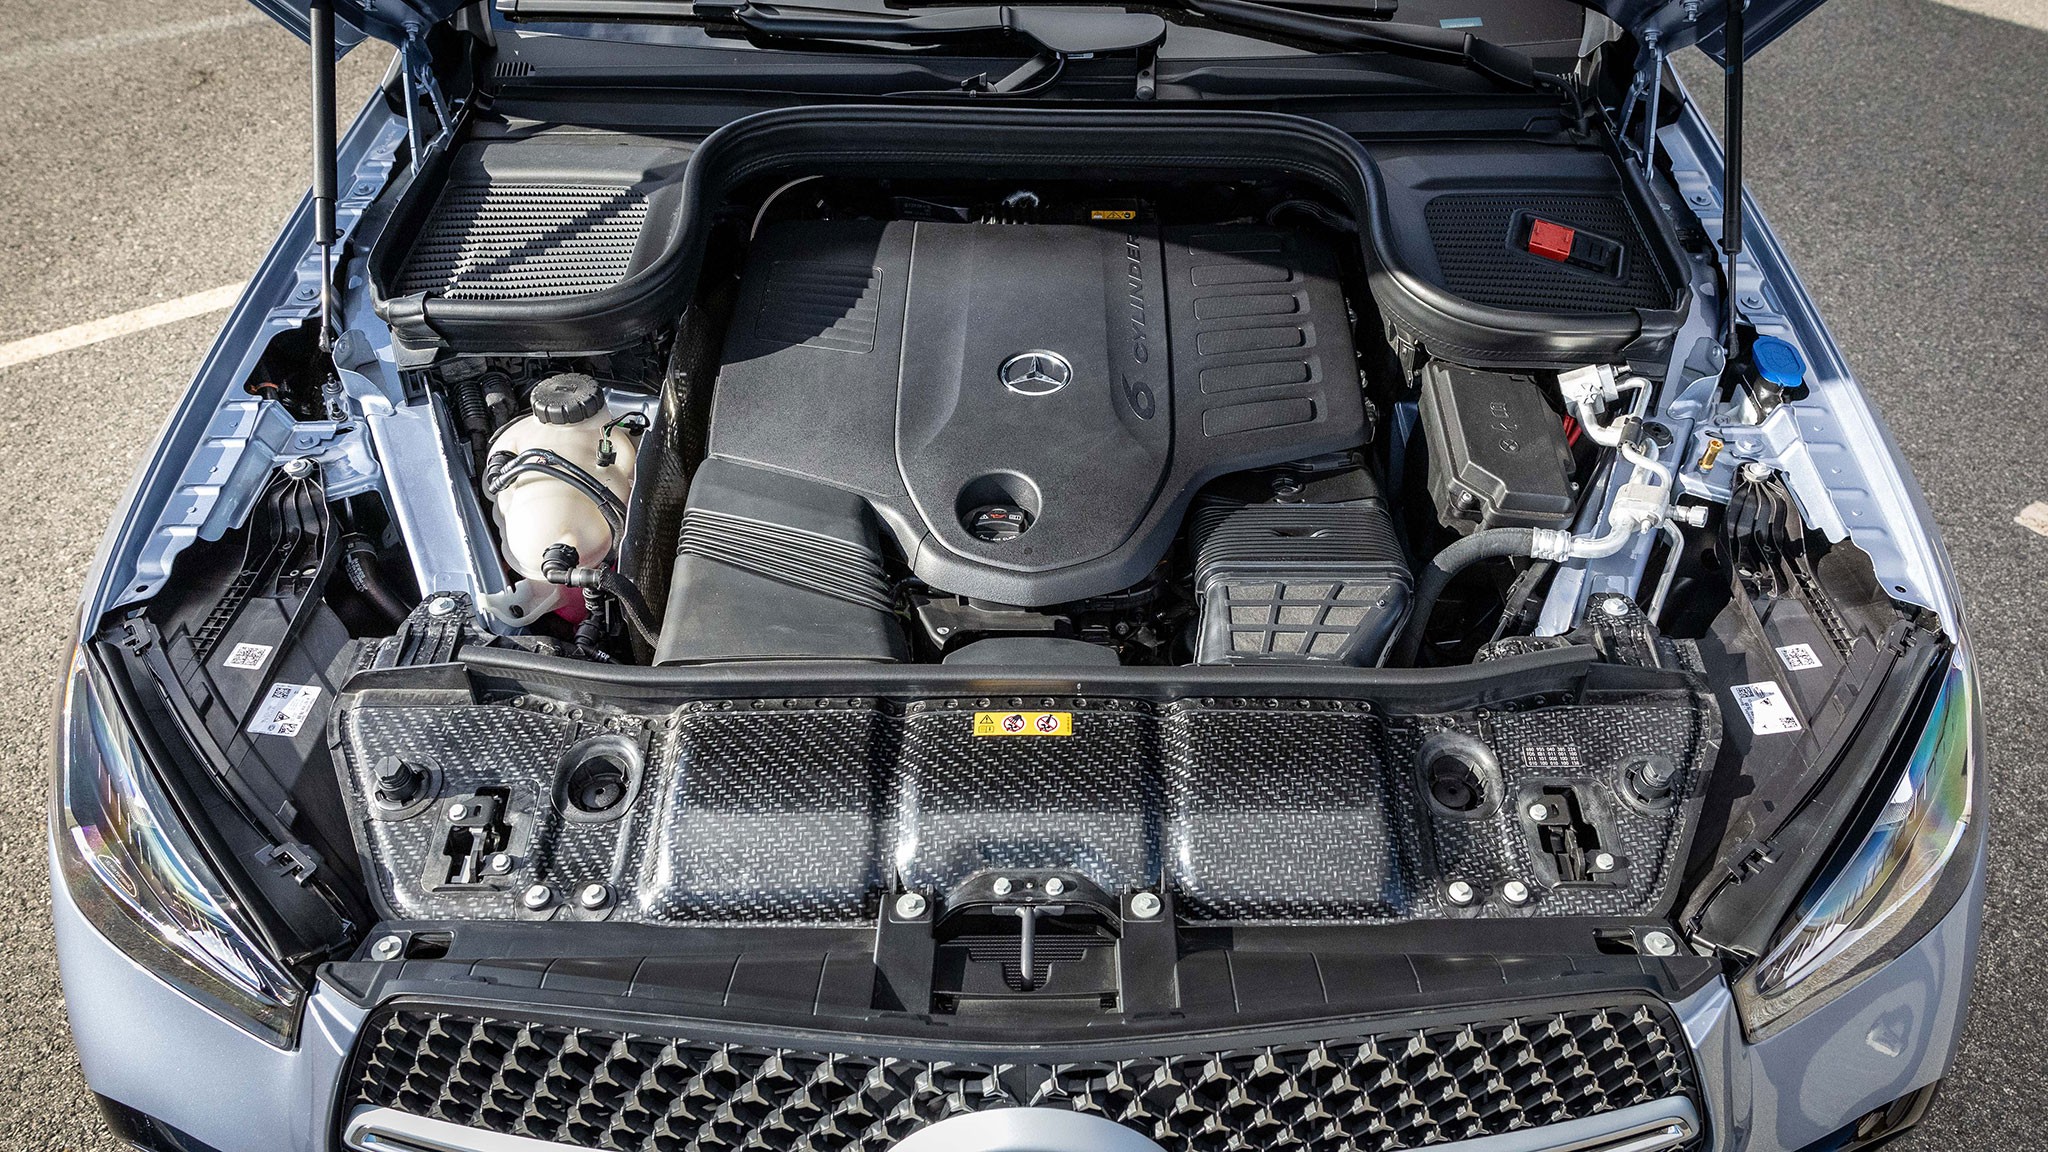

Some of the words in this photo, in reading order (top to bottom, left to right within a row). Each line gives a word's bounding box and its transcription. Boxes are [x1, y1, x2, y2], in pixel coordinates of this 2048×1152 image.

[1126, 232, 1149, 364] CYLINDER
[1121, 373, 1155, 421] 6
[597, 650, 610, 660] TOP
